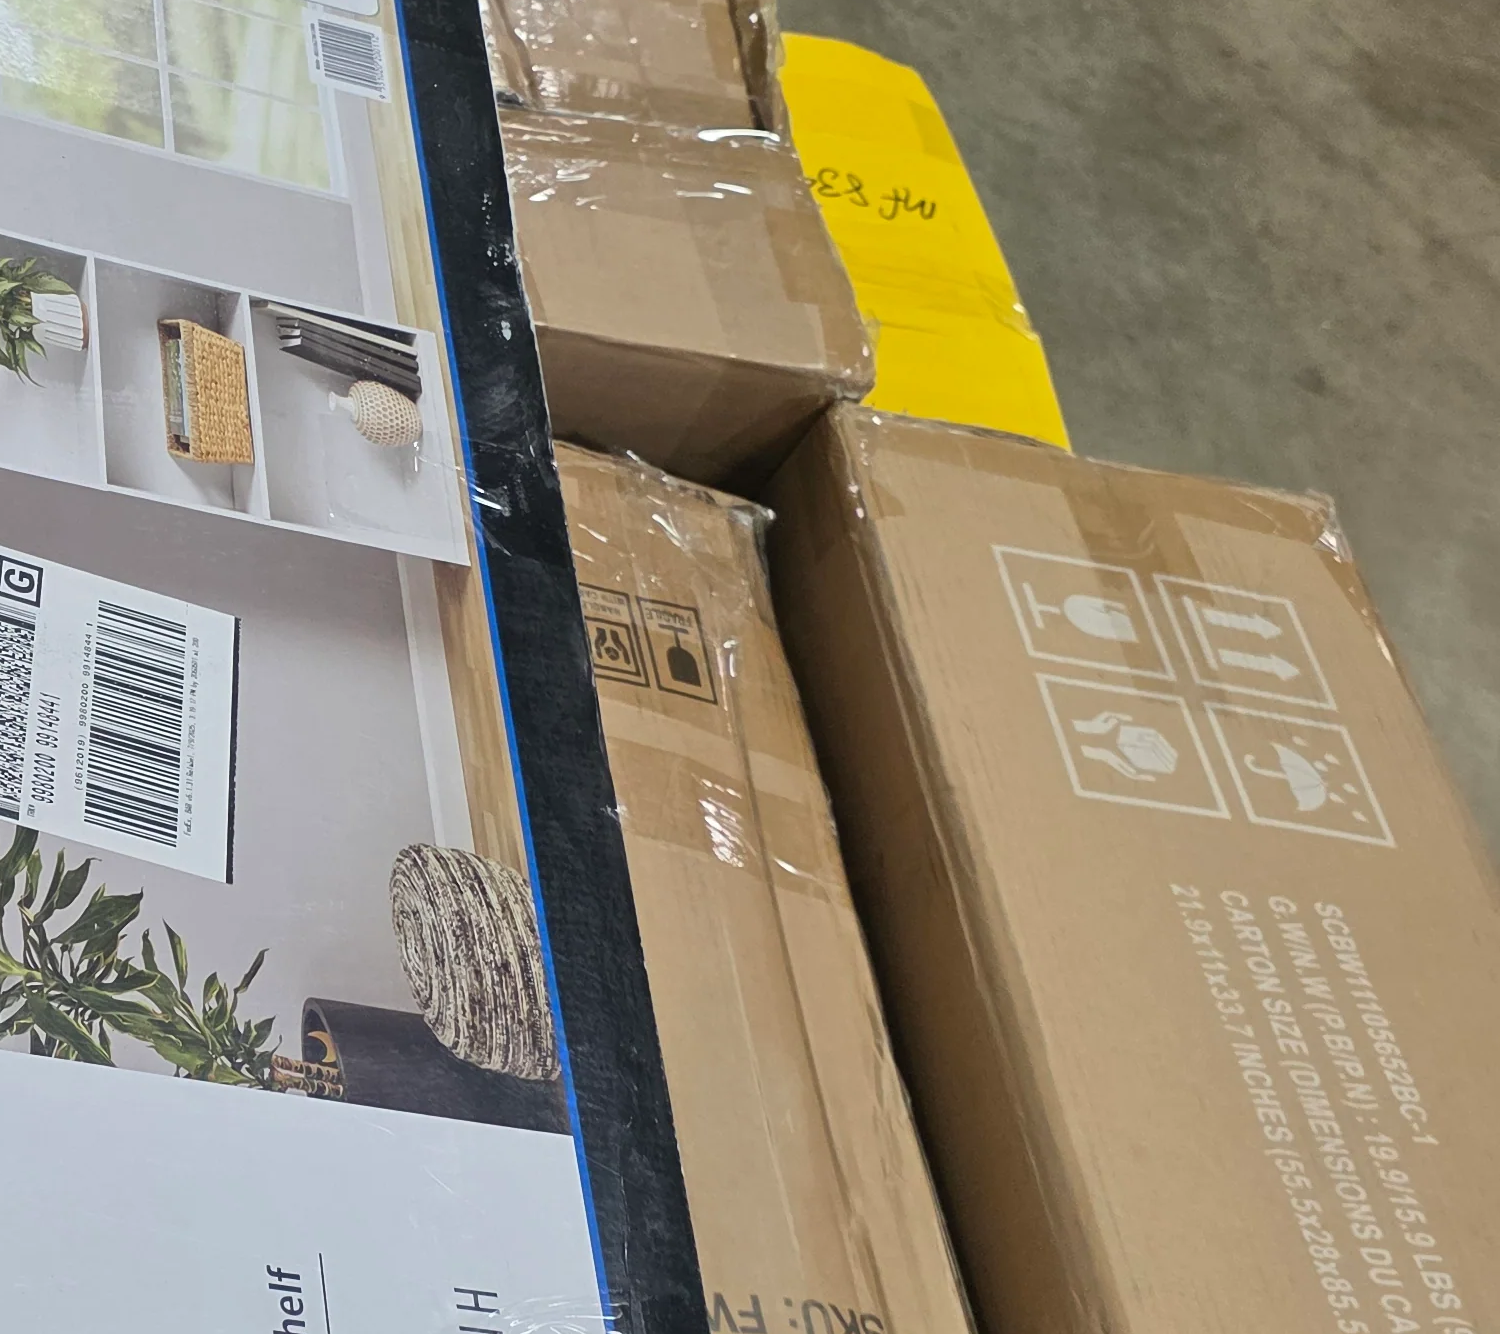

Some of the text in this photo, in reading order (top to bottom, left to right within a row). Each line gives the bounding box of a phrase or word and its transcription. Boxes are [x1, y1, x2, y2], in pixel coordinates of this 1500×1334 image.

[4, 568, 35, 594] G
[82, 633, 93, 677] 9914844
[78, 682, 89, 727] 9980200
[31, 692, 61, 804] 9980200 99148441
[74, 734, 87, 791] (9612019)
[1218, 889, 1286, 994] CARTON
[1262, 996, 1309, 1057] SIZE
[1230, 1042, 1295, 1145] INCHES
[1278, 1060, 1383, 1241] (DIMENSIONS
[1363, 1132, 1437, 1248] 19.9/15.9
[1411, 1253, 1462, 1311] LBS
[1359, 1246, 1403, 1289] DU
[453, 1287, 500, 1315] H
